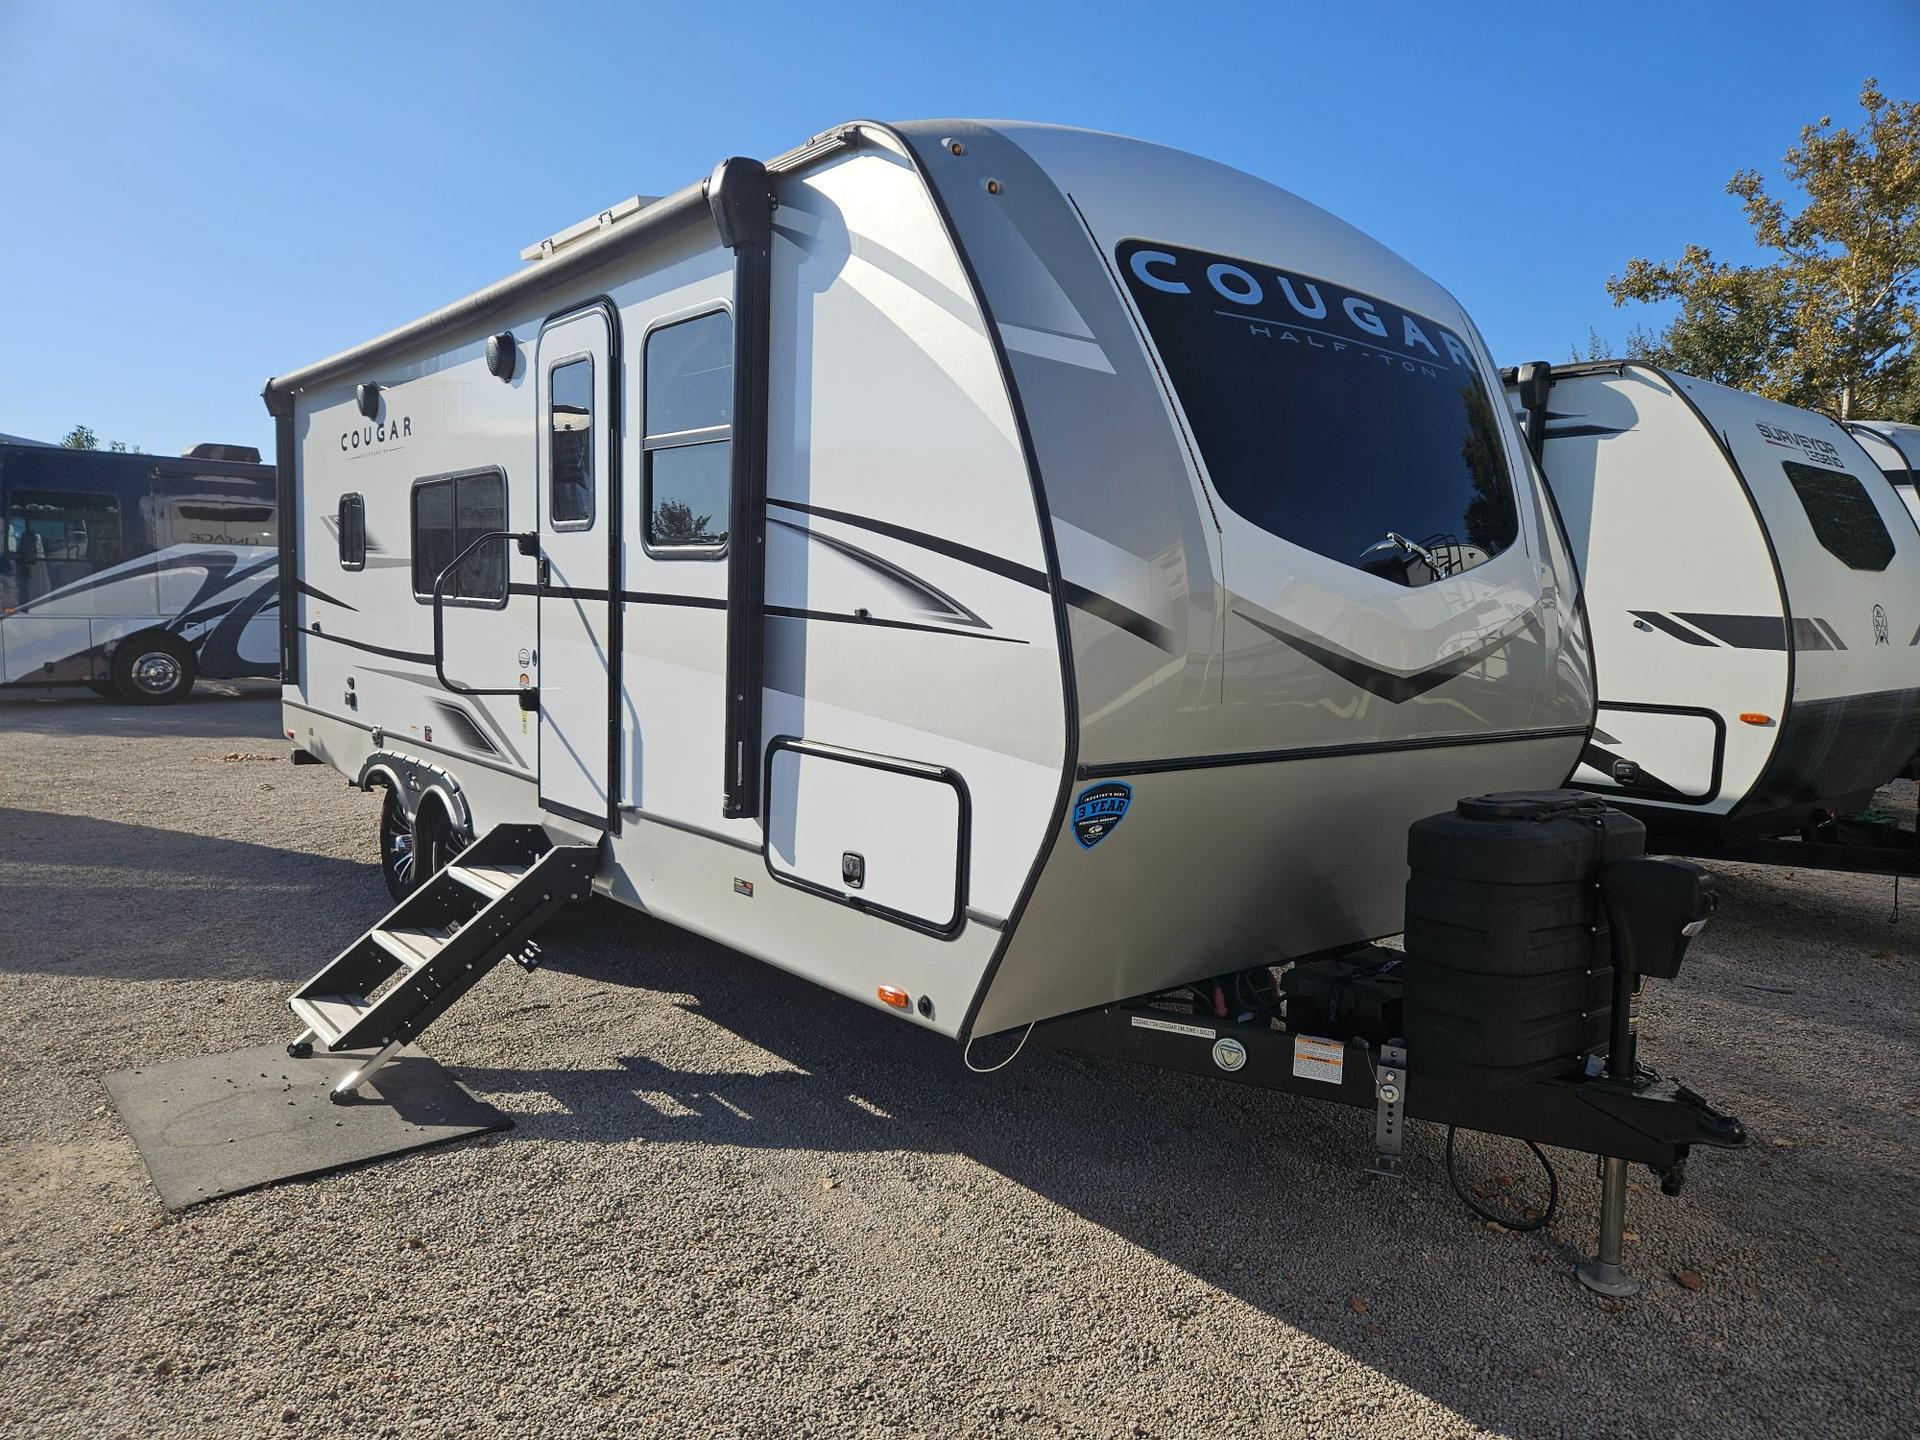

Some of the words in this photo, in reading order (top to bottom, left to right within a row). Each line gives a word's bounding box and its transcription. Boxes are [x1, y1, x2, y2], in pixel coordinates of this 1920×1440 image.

[1130, 250, 1477, 373] COUGAR
[1249, 325, 1438, 379] HALF-TON
[341, 416, 412, 451] COUGAR
[1755, 423, 1839, 457] SURVEYOR
[1079, 806, 1087, 818] 3
[1091, 799, 1125, 813] YEAR
